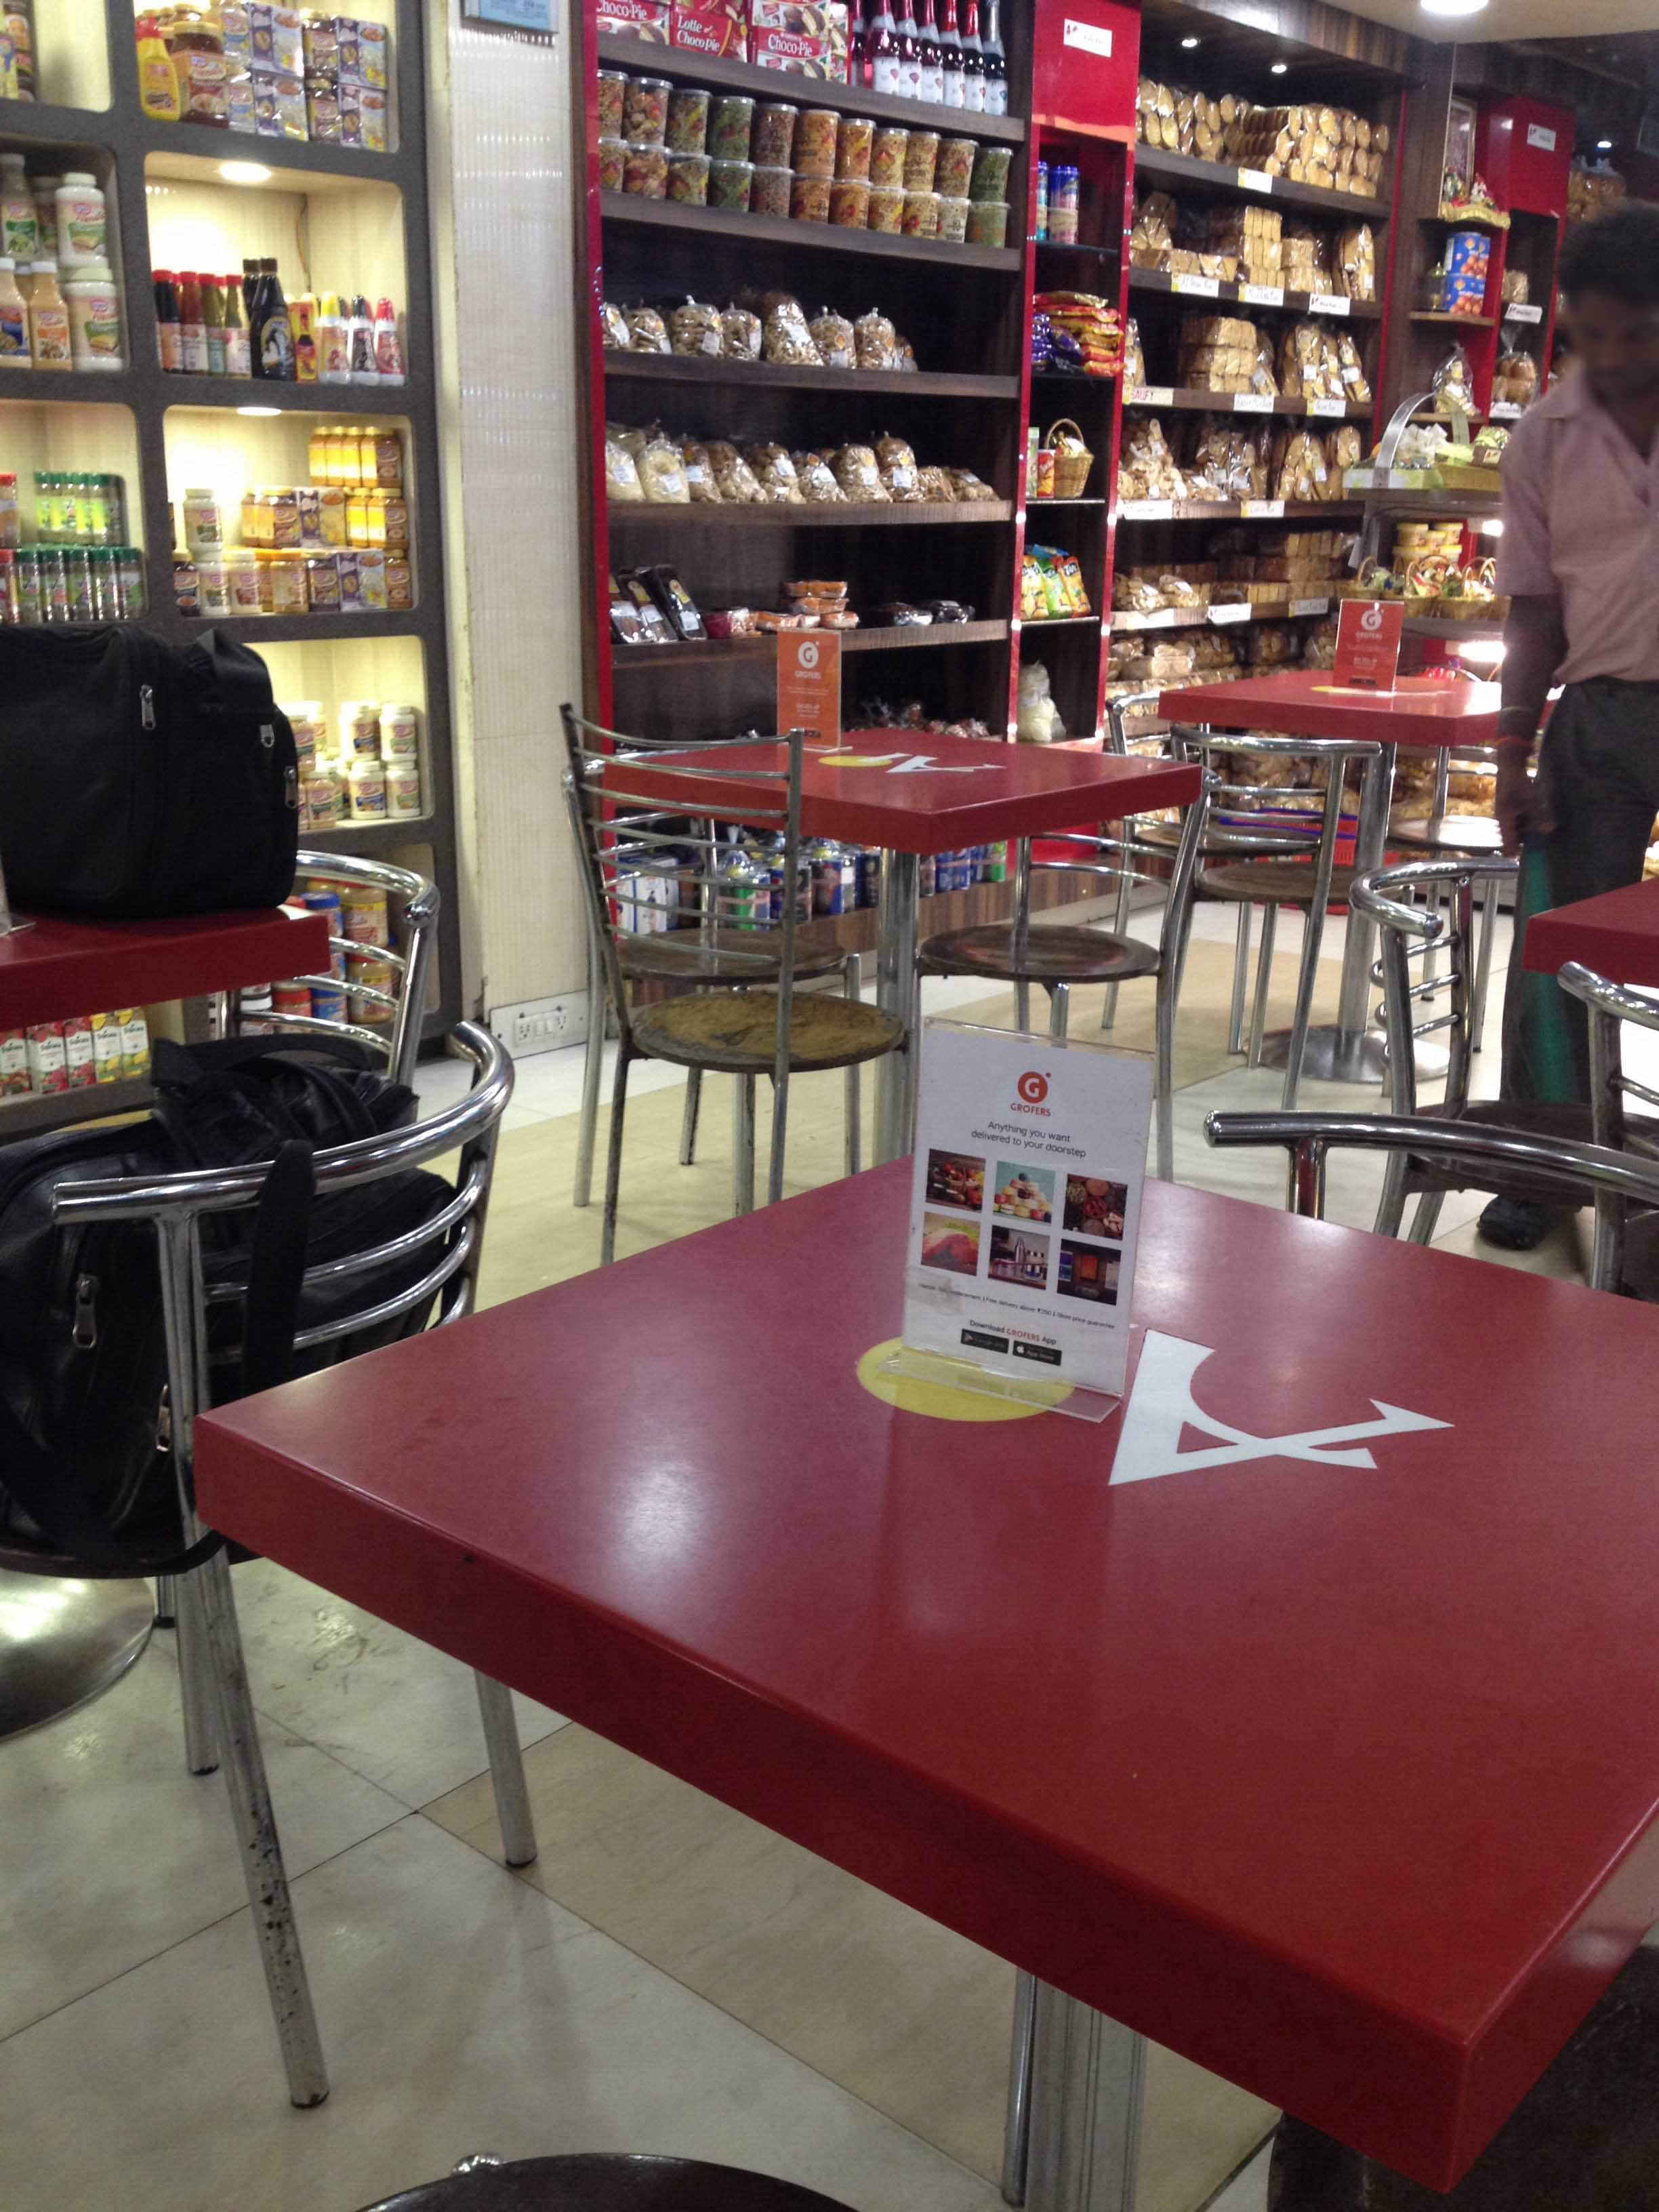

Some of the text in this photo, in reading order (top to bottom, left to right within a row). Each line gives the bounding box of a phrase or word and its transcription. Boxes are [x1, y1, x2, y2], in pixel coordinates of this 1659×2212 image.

[678, 15, 703, 33] Lotte
[677, 30, 705, 48] Choco
[1010, 1102, 1051, 1117] GROFERS
[988, 1121, 1071, 1143] Anything you want
[971, 1130, 1086, 1158] delivered to your doorstep
[969, 1319, 1057, 1345] Download GROFERS App
